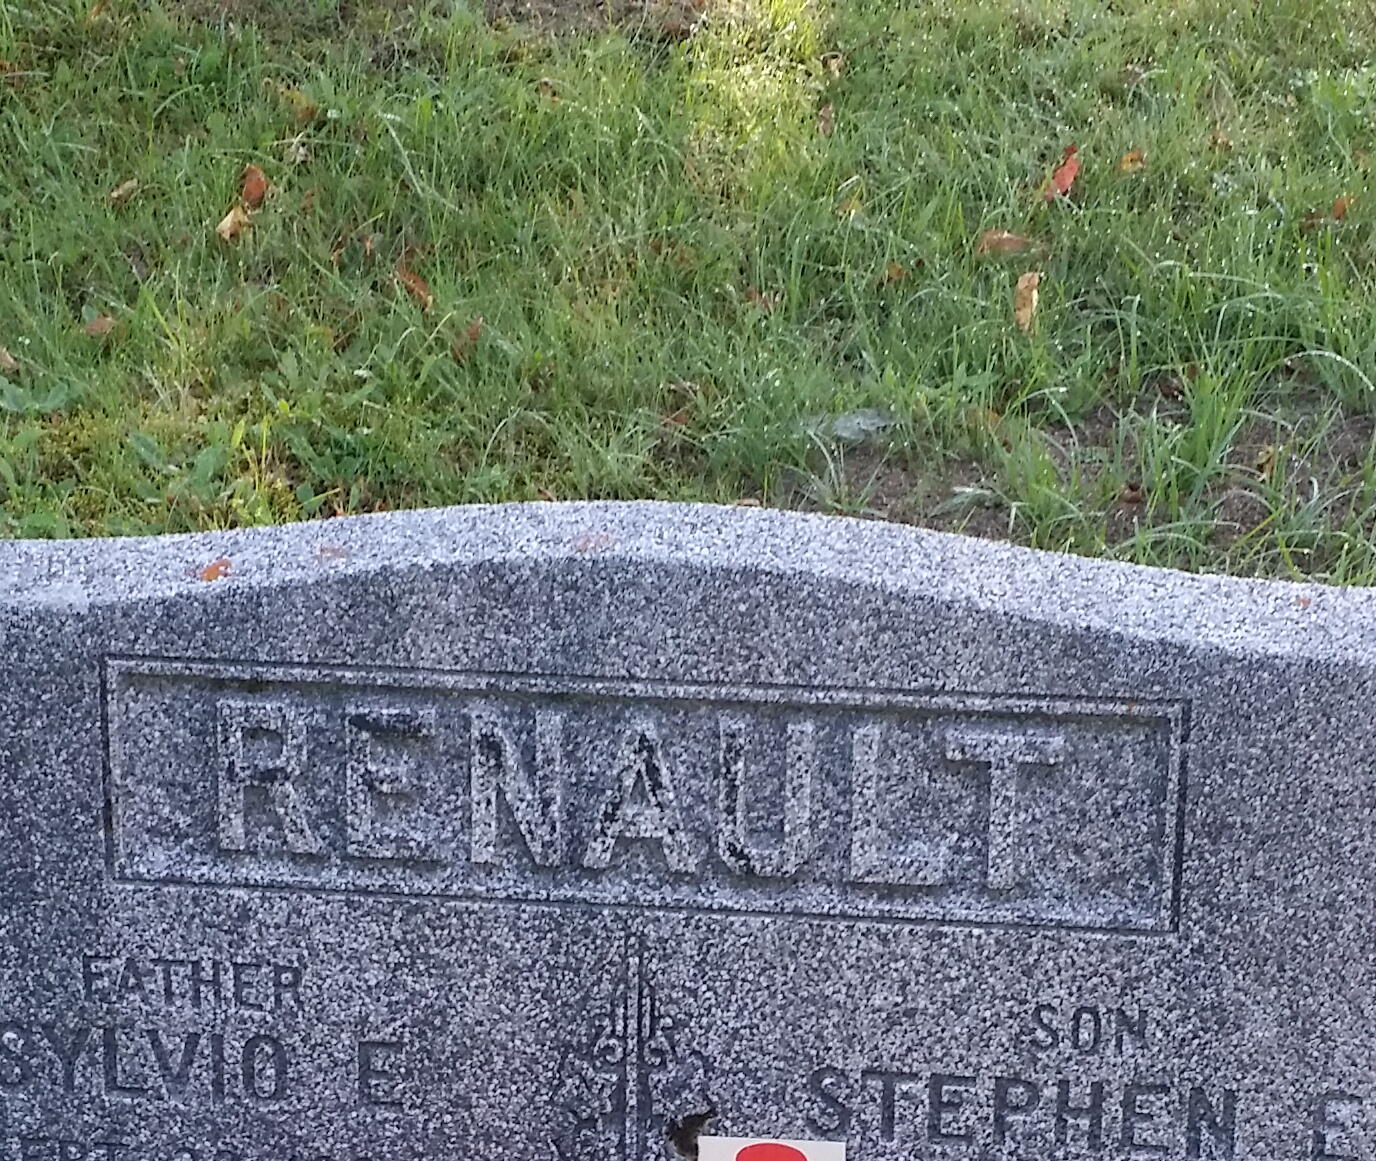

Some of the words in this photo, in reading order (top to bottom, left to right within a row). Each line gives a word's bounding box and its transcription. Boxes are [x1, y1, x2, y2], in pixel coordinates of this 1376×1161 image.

[215, 698, 1070, 892] RENAULT
[82, 954, 305, 1011] FATHER
[1027, 1003, 1147, 1055] SON
[356, 1037, 408, 1109] E
[806, 1066, 1238, 1161] STEPHEN
